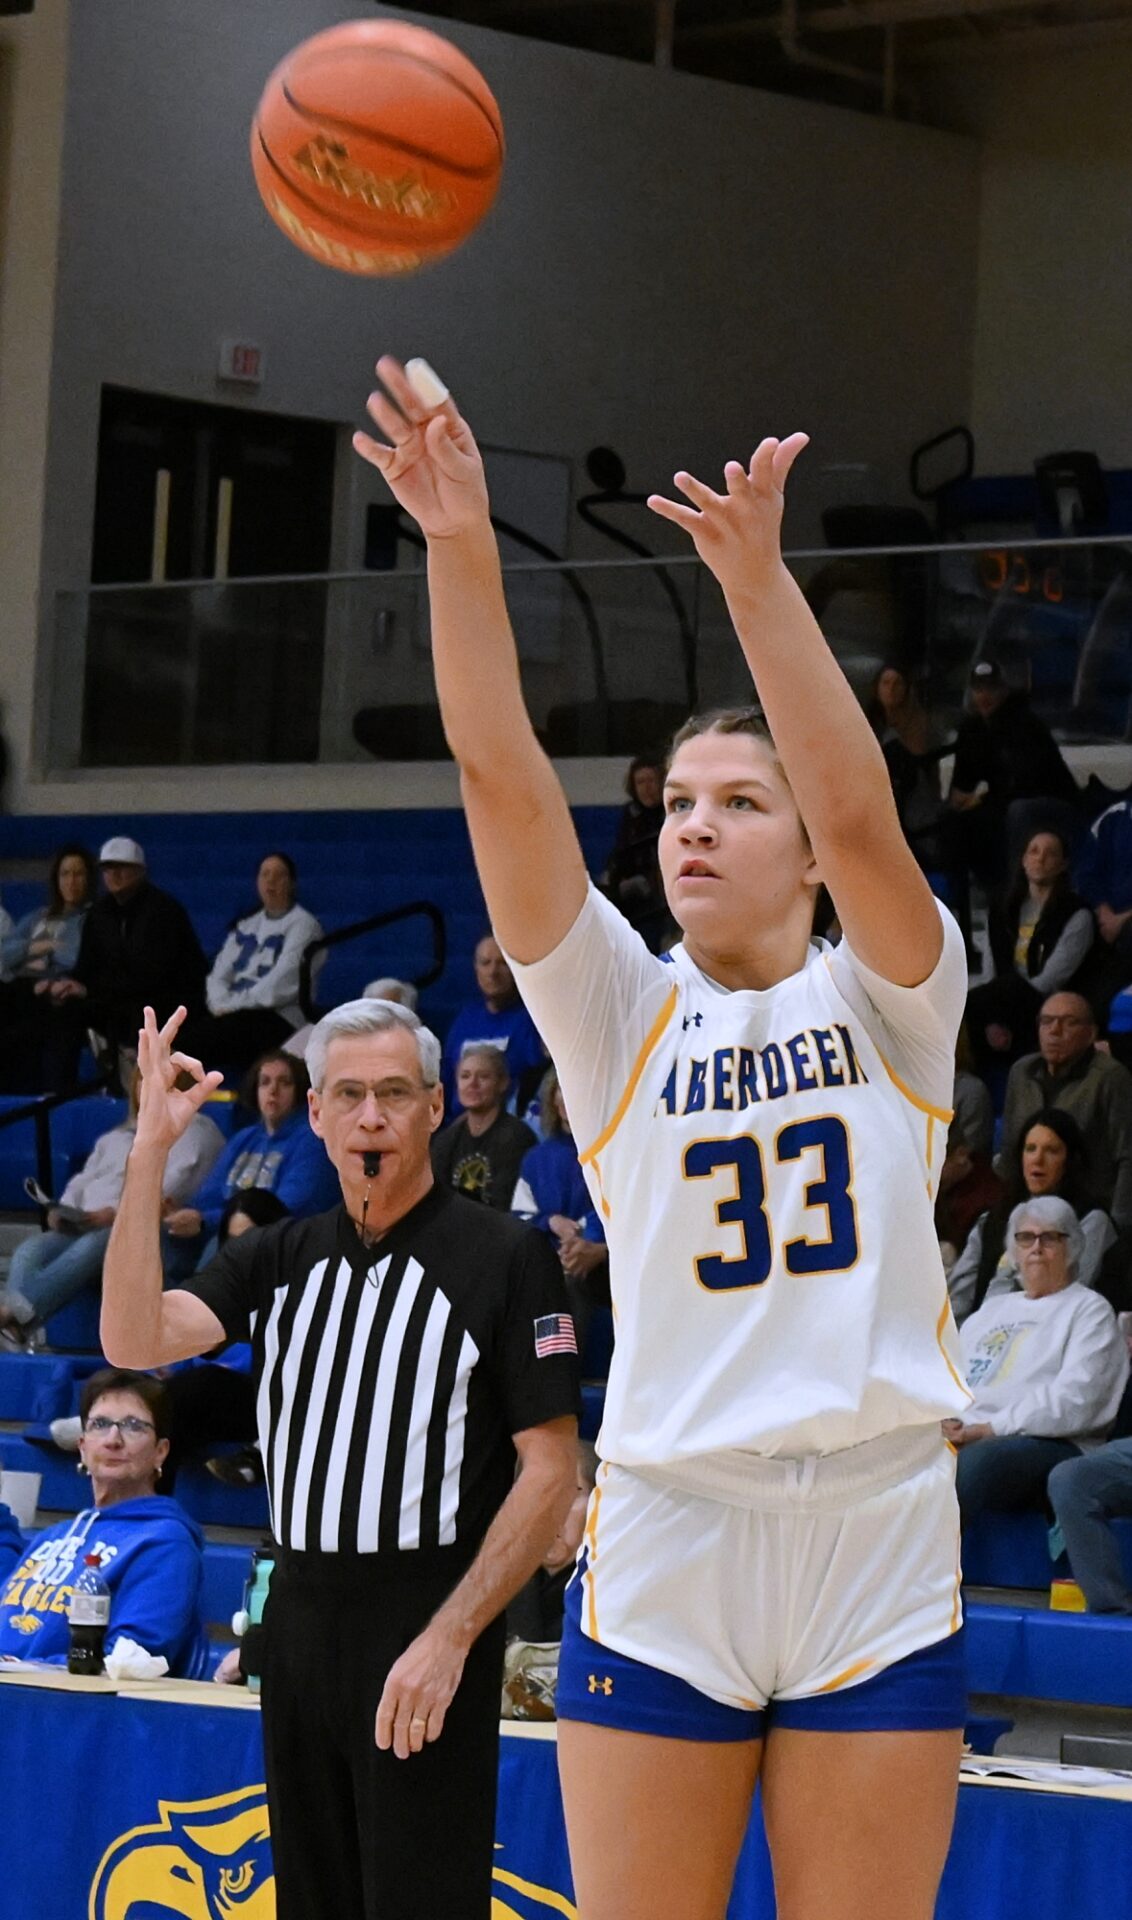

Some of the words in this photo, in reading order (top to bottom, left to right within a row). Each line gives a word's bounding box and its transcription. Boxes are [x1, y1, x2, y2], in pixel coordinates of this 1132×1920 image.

[653, 1023, 870, 1118] ABERDEEN
[680, 1112, 863, 1295] 33
[3, 1580, 74, 1617] AGLE
